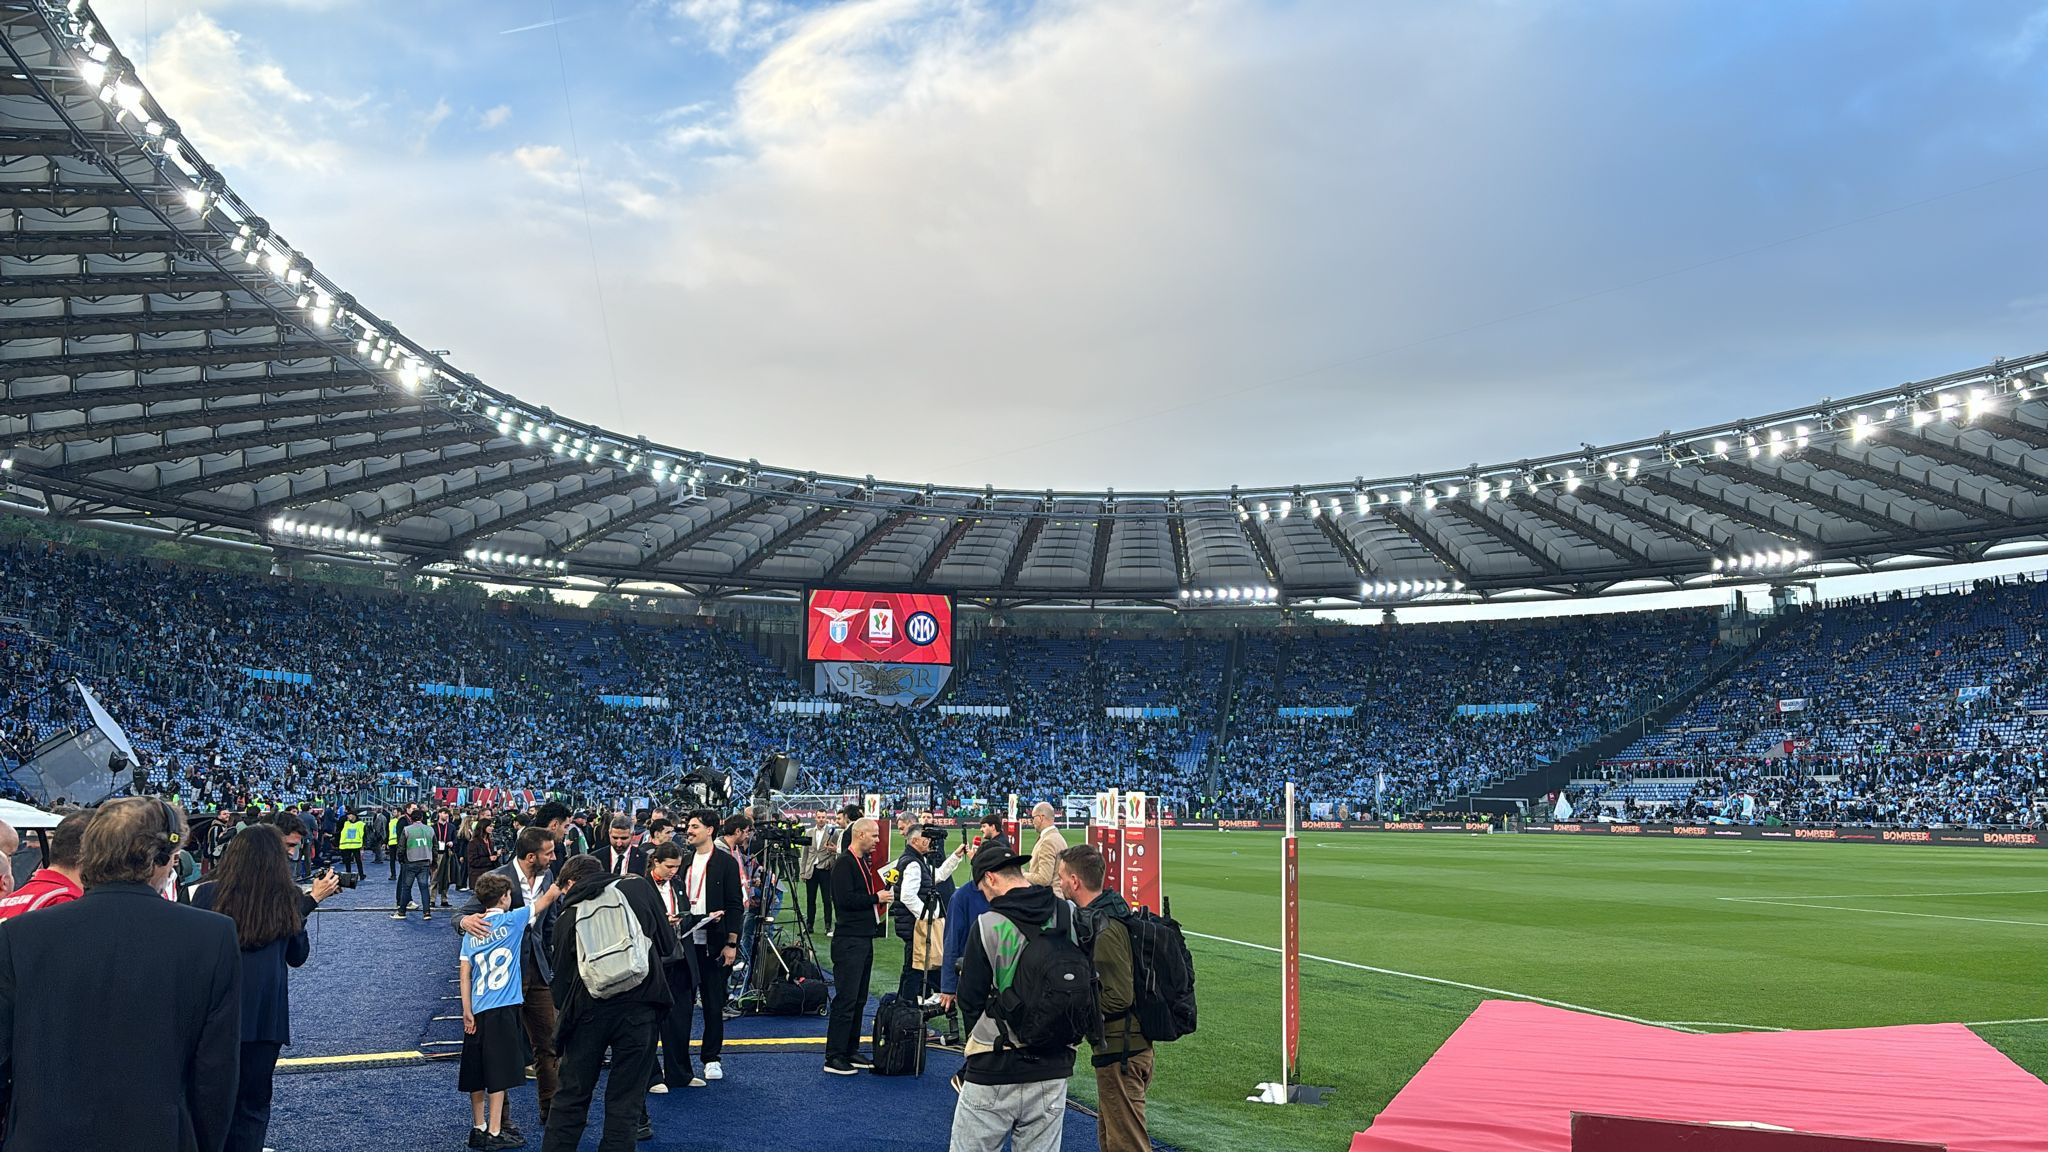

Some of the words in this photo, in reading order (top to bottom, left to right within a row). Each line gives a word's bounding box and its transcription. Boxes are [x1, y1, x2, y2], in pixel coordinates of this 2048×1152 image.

[1795, 829, 1836, 838] BOMBEER
[1883, 831, 1930, 841] BOMBEER
[1984, 833, 2036, 843] BOMBEER
[474, 947, 513, 996] 18
